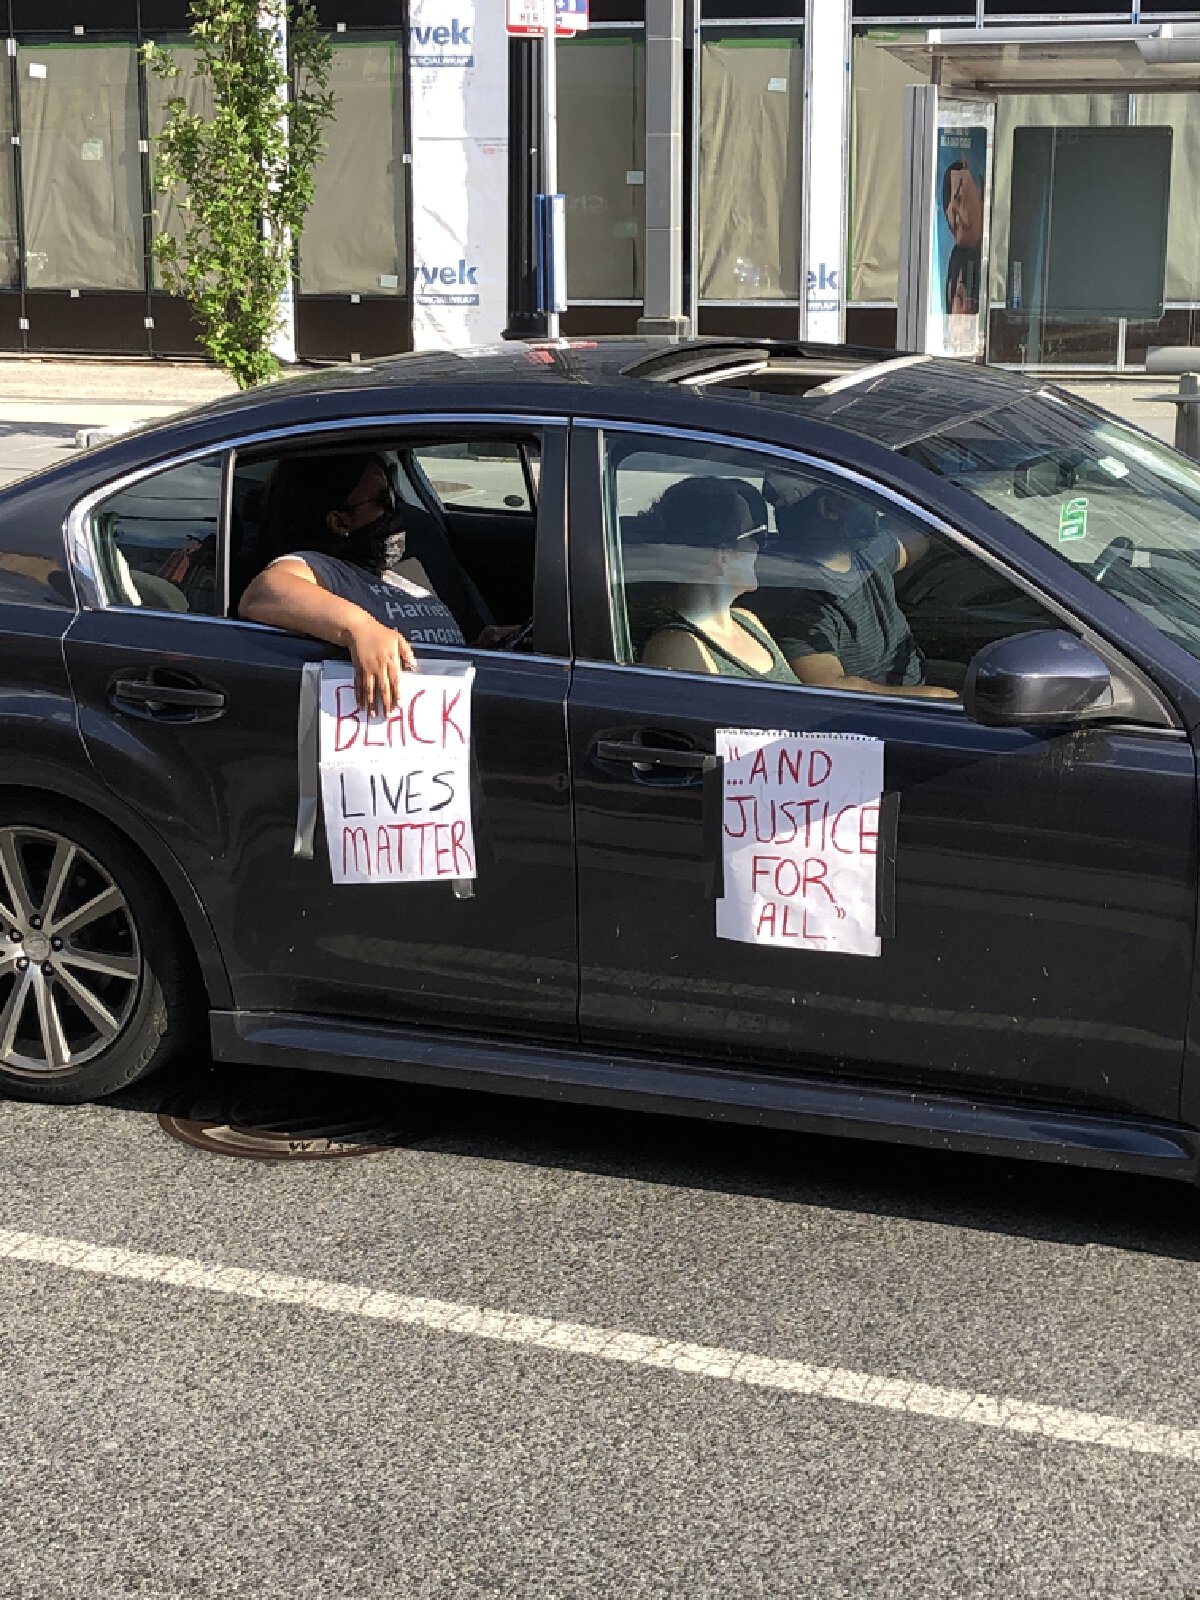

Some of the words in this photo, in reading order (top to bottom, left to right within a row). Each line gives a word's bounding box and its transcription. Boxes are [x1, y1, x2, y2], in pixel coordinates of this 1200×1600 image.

[335, 685, 465, 751] BLACK
[340, 770, 455, 819] LIVES
[343, 820, 474, 876] MATTER
[723, 795, 880, 854] JUSTICE
[752, 855, 836, 903] FOR
